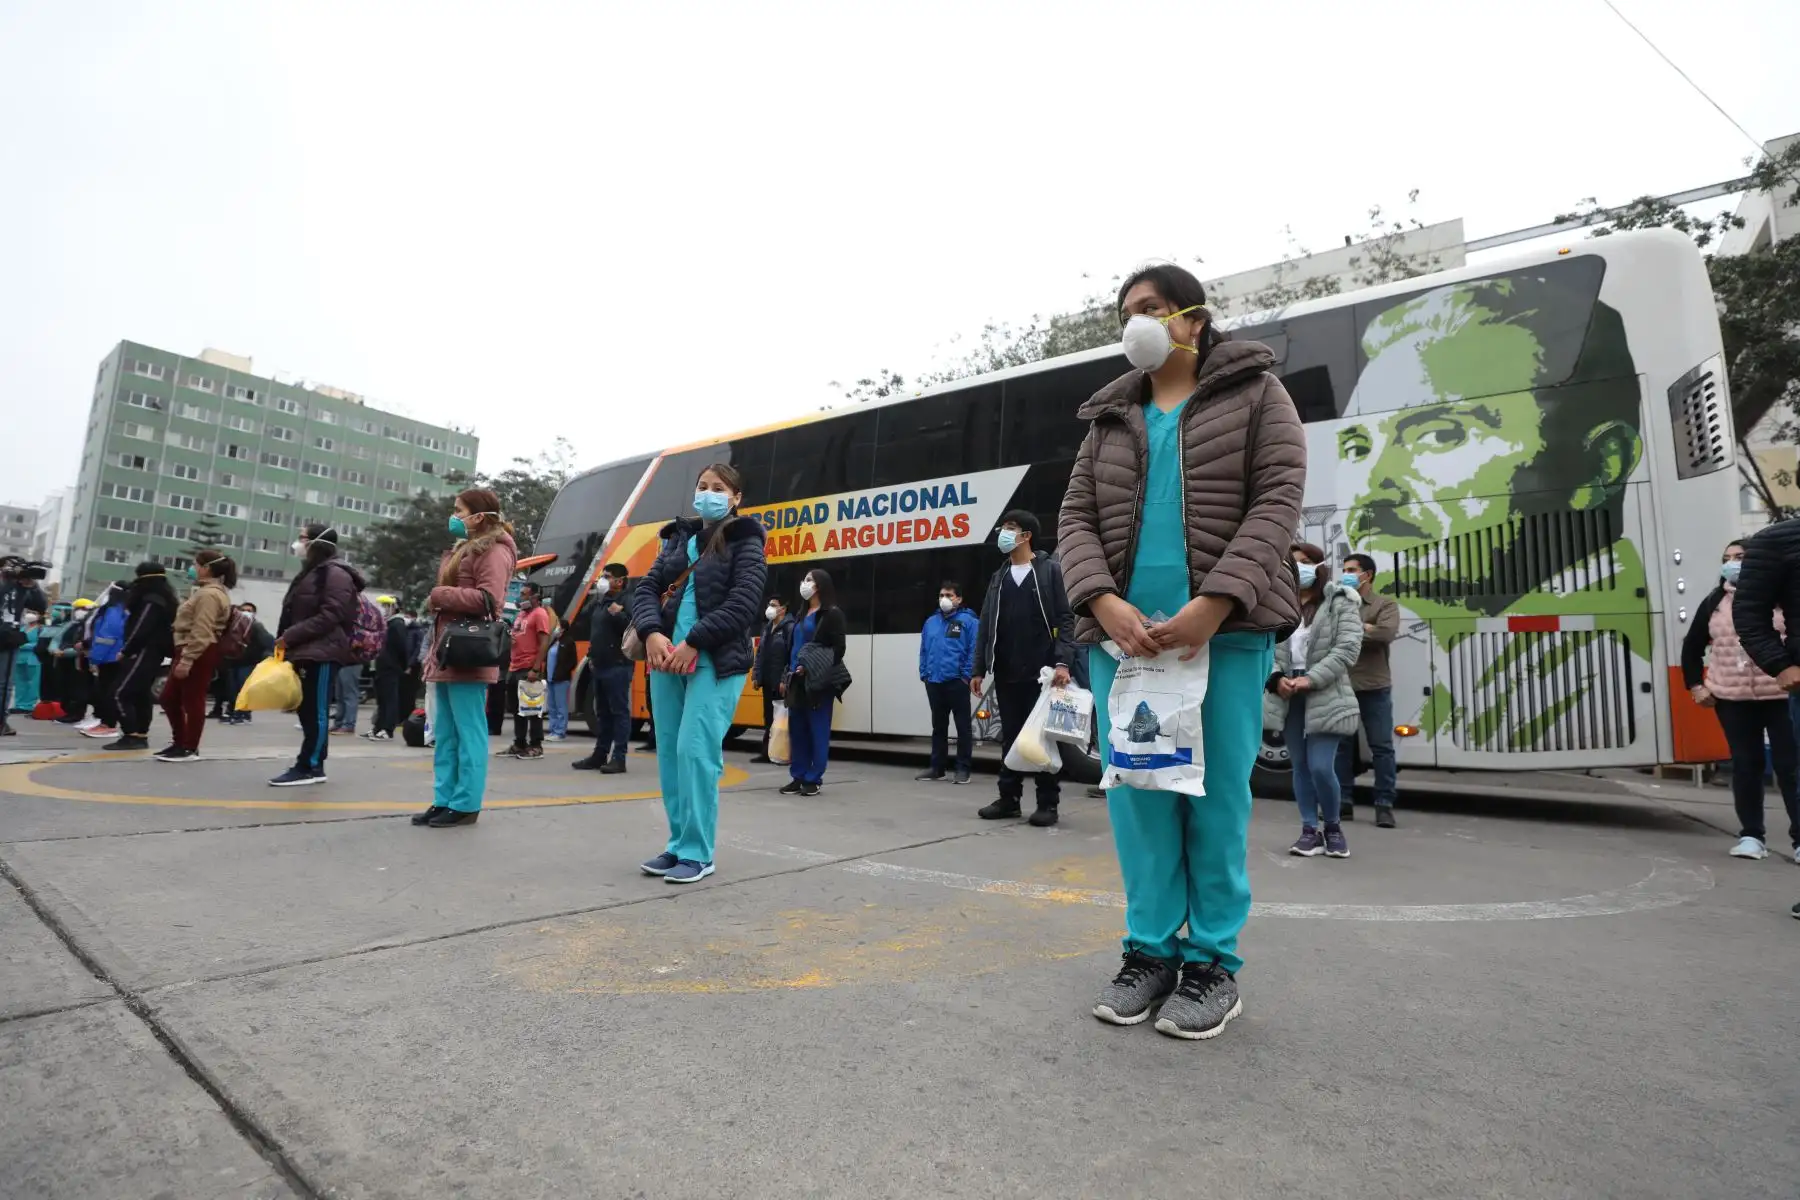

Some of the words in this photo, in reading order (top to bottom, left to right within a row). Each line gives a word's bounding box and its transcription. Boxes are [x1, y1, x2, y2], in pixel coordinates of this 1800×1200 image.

[749, 503, 829, 531] SIDAD
[837, 481, 977, 521] NACIONAL
[764, 528, 817, 557] ARÍA
[823, 513, 970, 552] ARGUEDAS
